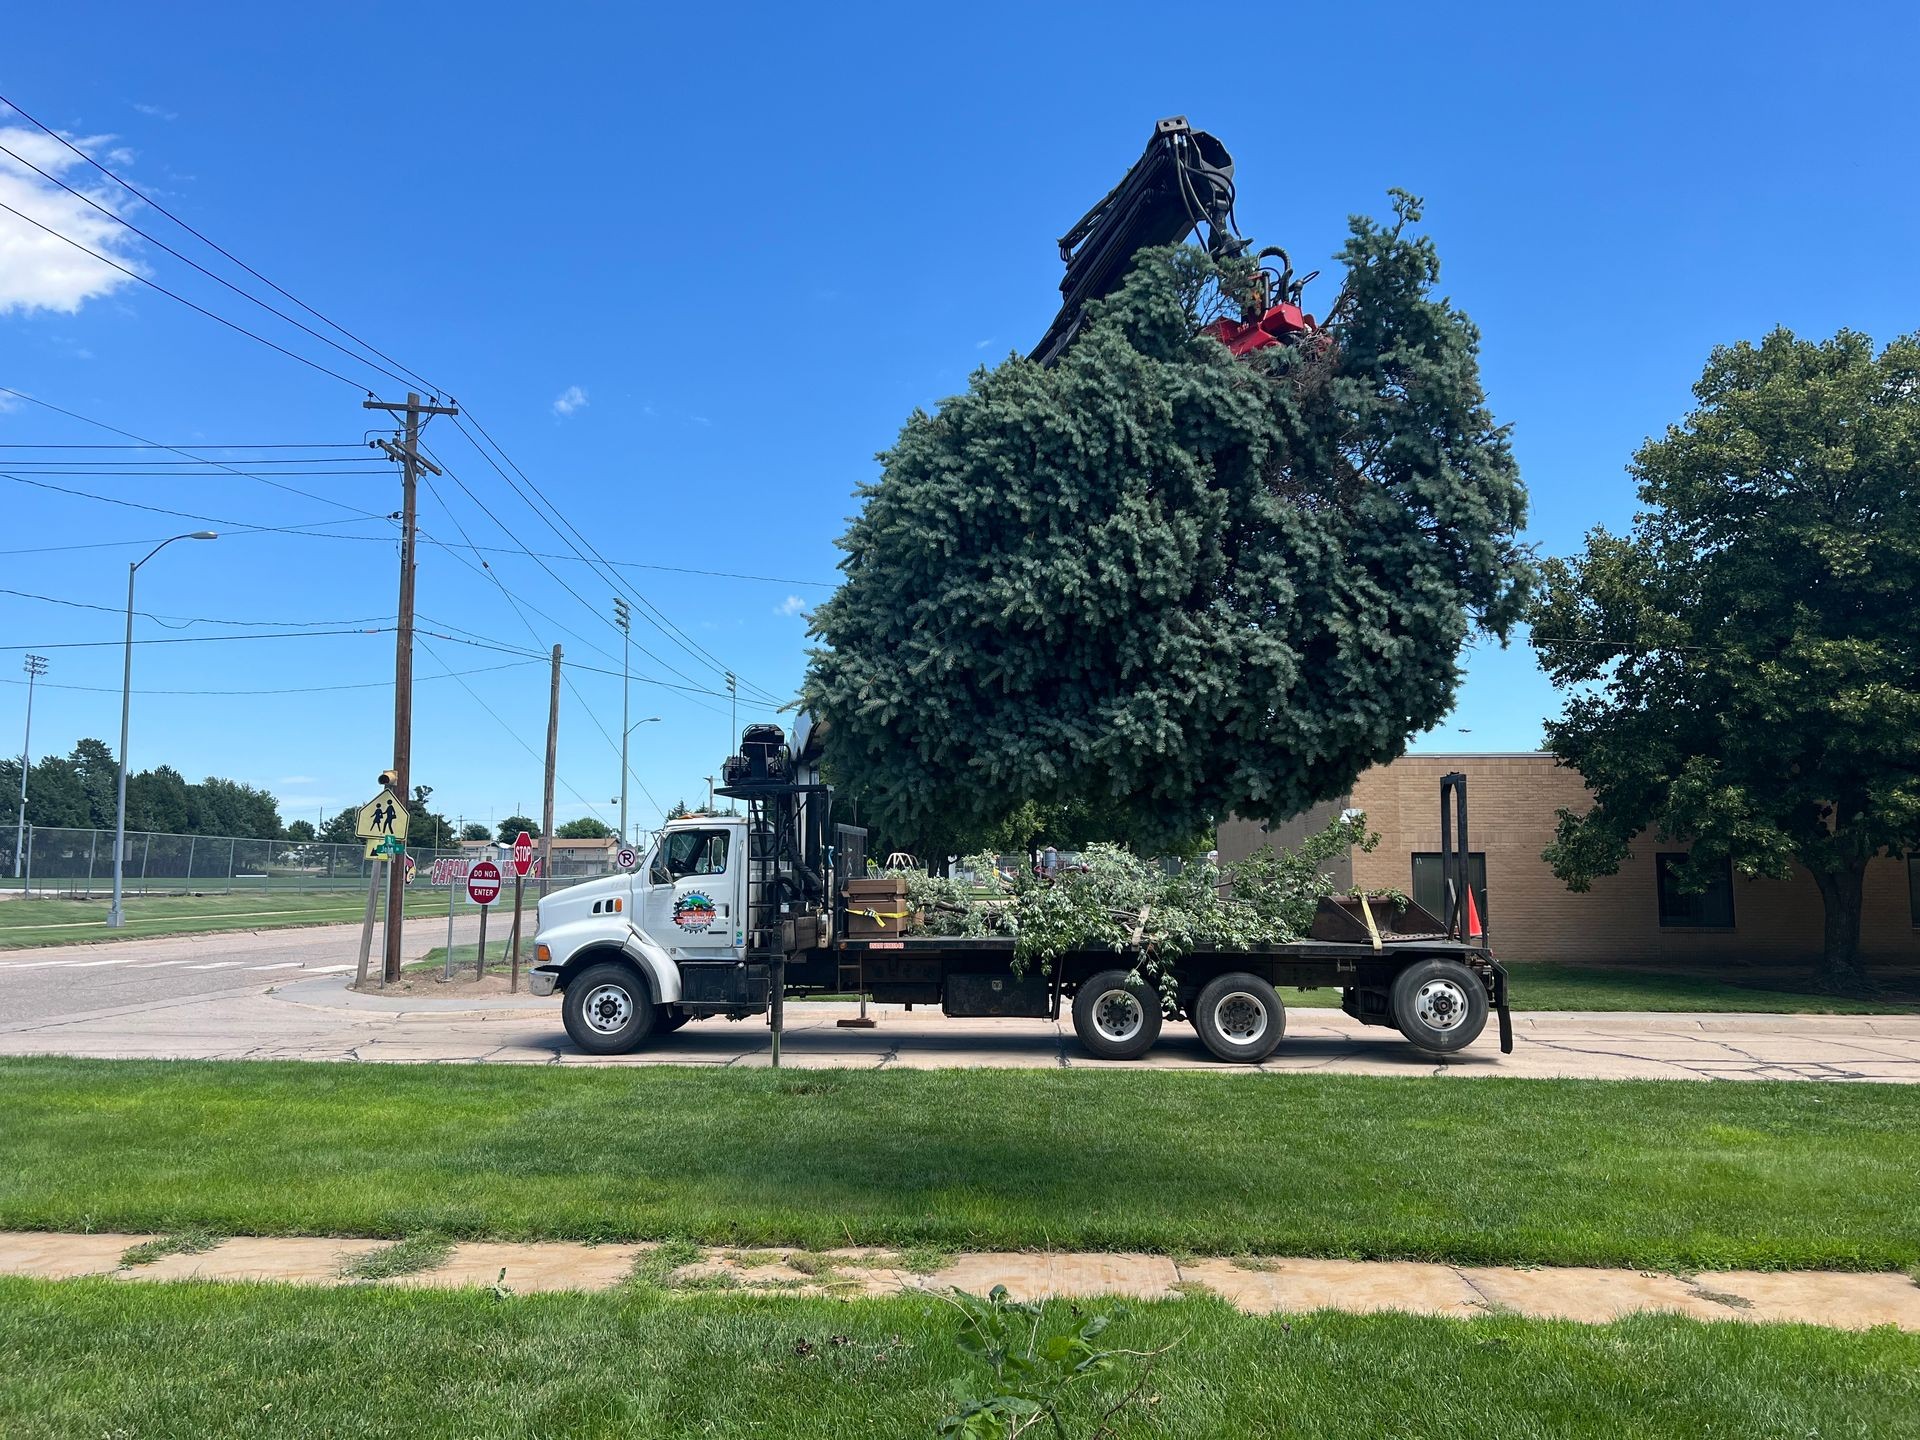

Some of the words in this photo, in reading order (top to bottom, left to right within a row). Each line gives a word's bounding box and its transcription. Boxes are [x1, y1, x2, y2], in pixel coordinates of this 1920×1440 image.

[515, 845, 531, 862] STOP
[485, 870, 497, 878] NOT
[474, 888, 494, 897] ENTER
